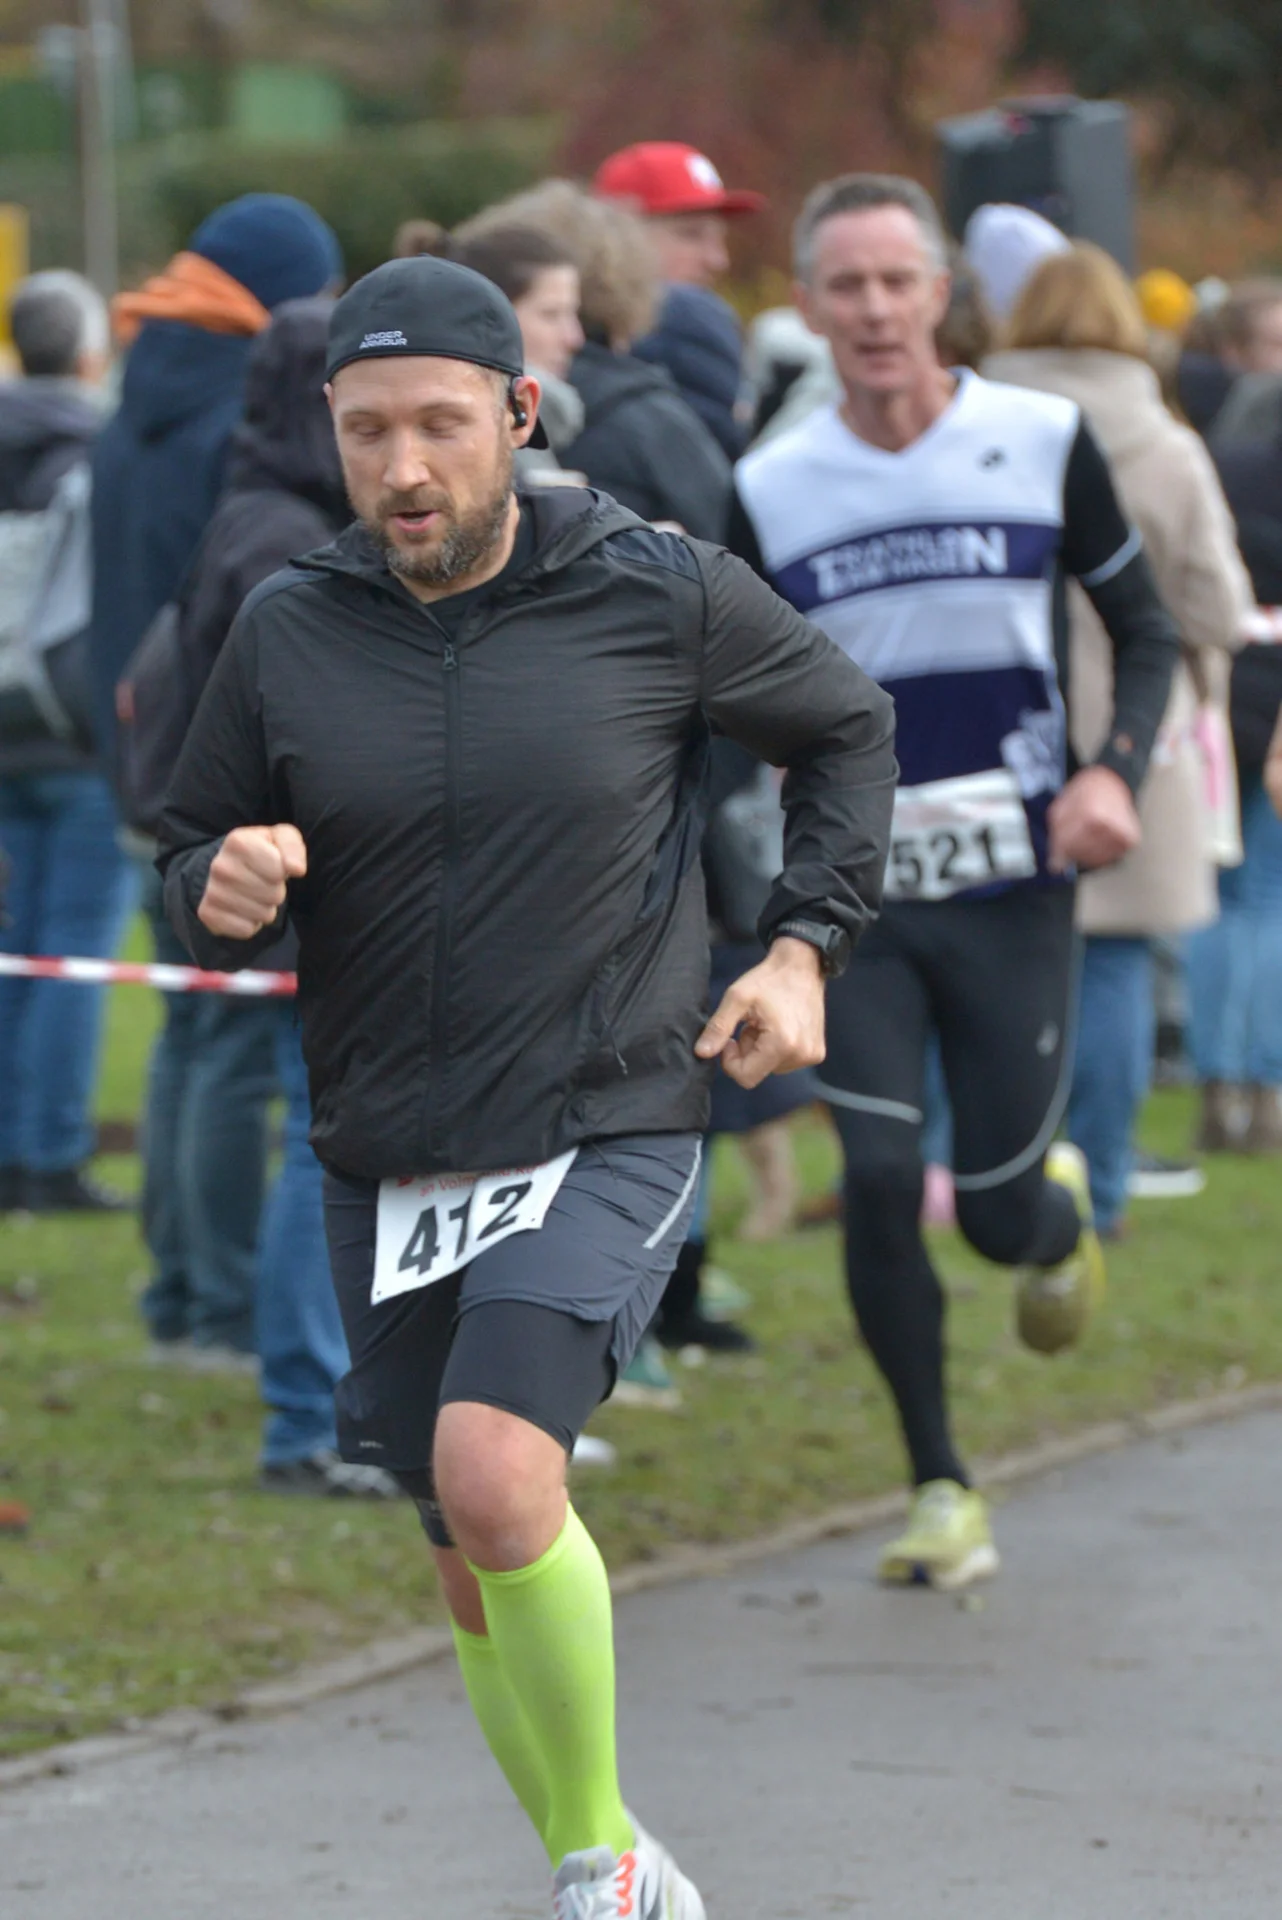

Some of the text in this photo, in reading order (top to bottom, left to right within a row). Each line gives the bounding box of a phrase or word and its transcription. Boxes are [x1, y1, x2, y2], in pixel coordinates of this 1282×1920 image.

[359, 338, 407, 349] ARMOUR
[364, 330, 402, 340] UNDER
[891, 823, 998, 887] 521
[398, 1181, 532, 1275] 412
